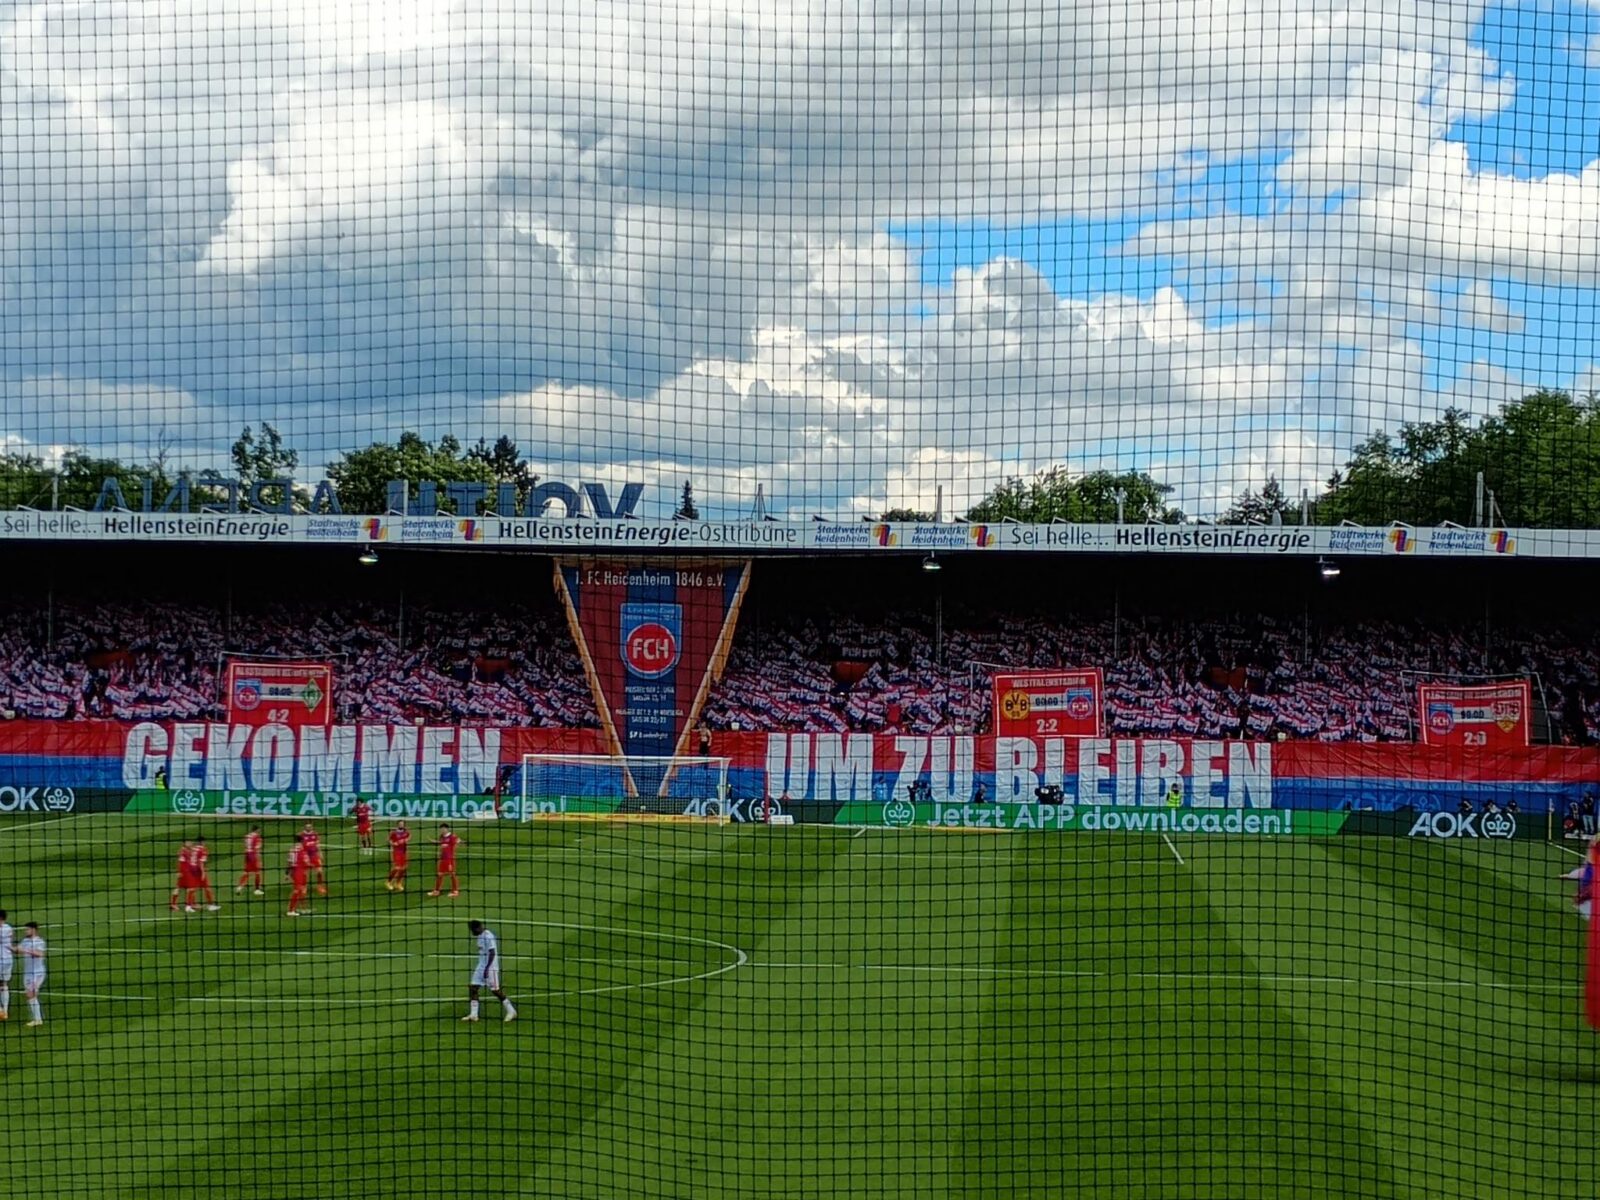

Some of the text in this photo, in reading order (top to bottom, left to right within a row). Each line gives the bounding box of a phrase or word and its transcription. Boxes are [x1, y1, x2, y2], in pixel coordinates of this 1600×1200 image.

[4, 514, 290, 540] Sei helle... HellensteinEnergie
[499, 520, 797, 545] HellensteinEnergie-Osttribüne
[1011, 526, 1311, 552] Sei helle... HellensteinEnergie
[604, 570, 671, 586] Heidenheim
[675, 571, 703, 586] 1846
[632, 638, 669, 660] FCH
[122, 721, 1272, 808] GEKOMMEN UM ZU BLEIBEN
[215, 791, 293, 814] Jetzt
[300, 792, 357, 816] APP
[682, 798, 747, 822] AOK
[926, 804, 1292, 834] Jetzt APP downloaden!
[1408, 811, 1479, 838] AOK
